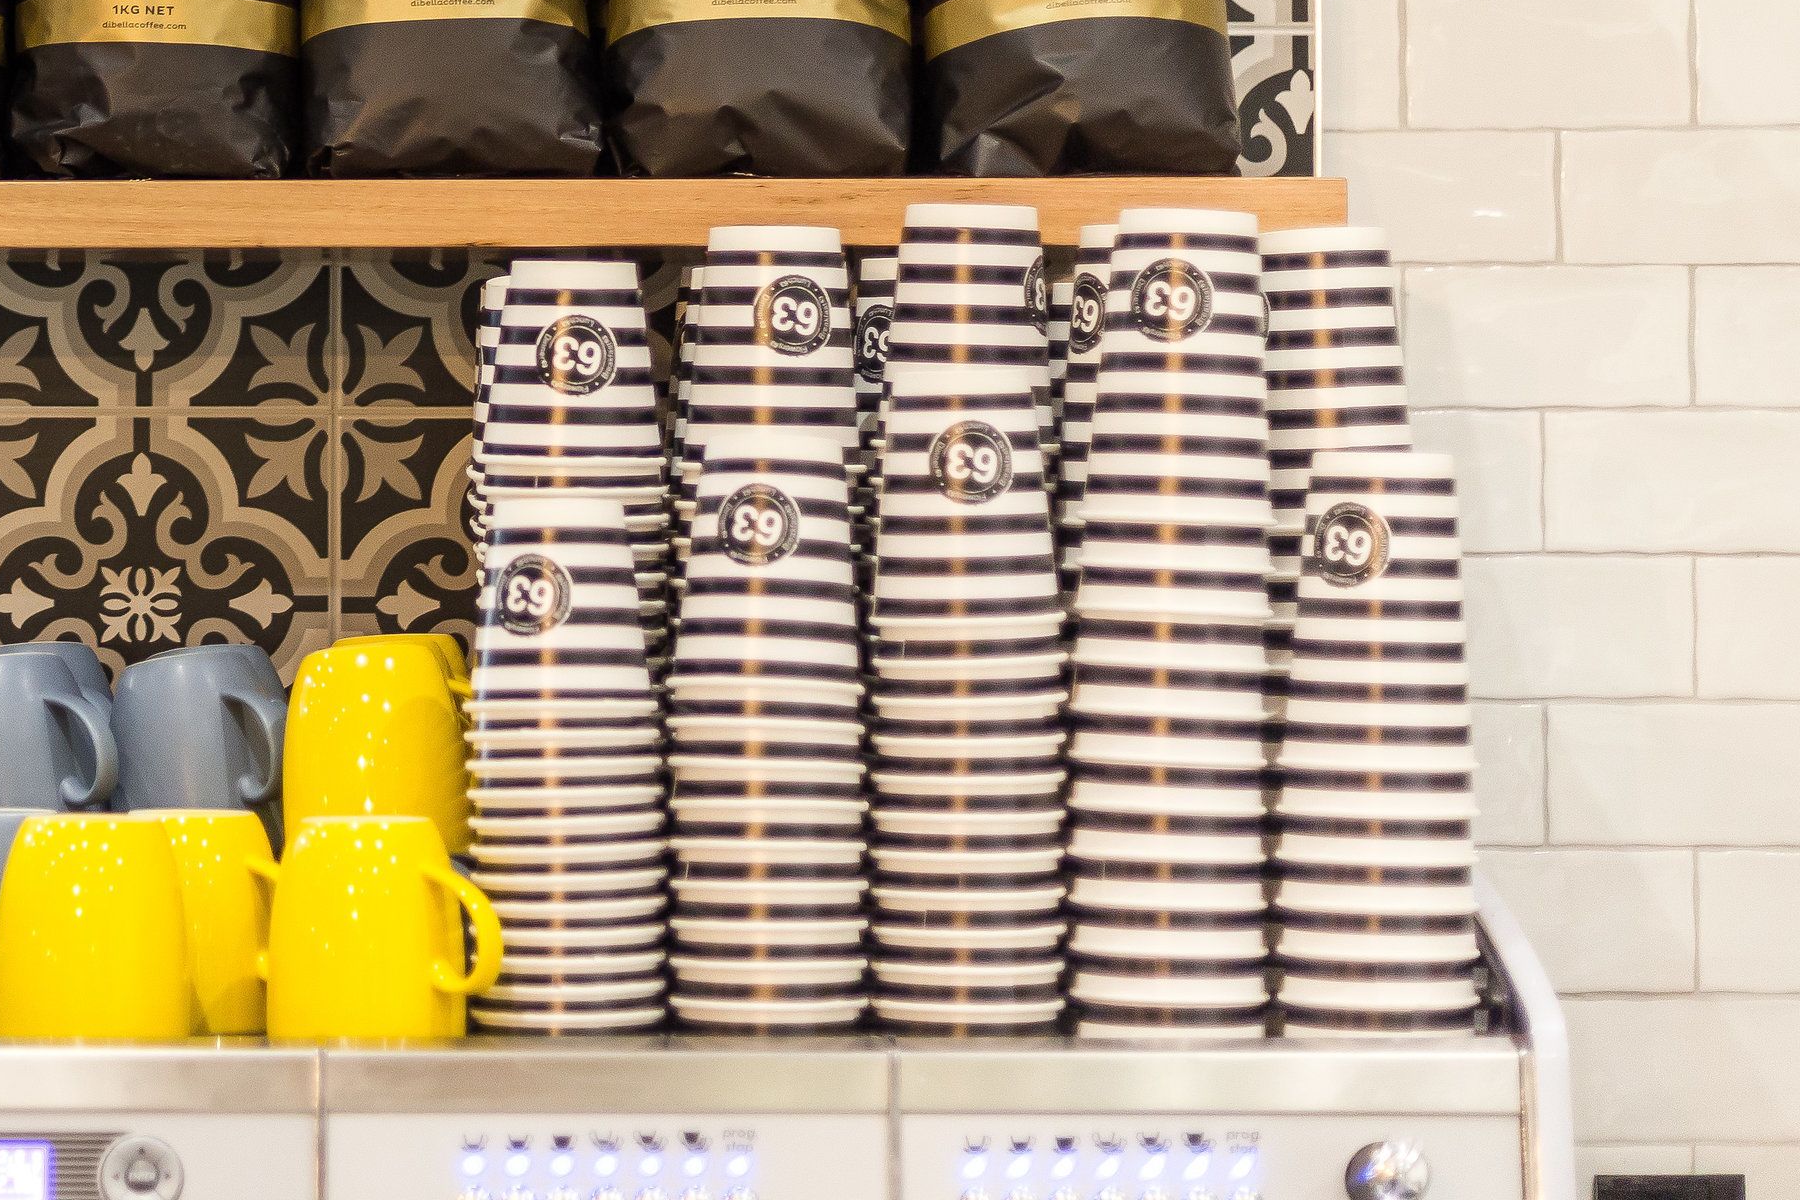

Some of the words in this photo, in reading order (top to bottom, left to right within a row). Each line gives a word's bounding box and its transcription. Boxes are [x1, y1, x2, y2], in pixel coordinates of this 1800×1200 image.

[102, 20, 187, 30] dibellacoffee.com
[112, 4, 140, 15] 1KG
[145, 5, 174, 16] NET
[770, 295, 819, 336] 63
[1144, 280, 1197, 322] 63
[552, 335, 603, 376] 63
[946, 442, 998, 482] 63
[731, 504, 785, 547] 63
[1324, 522, 1372, 566] 63
[506, 575, 556, 611] 63
